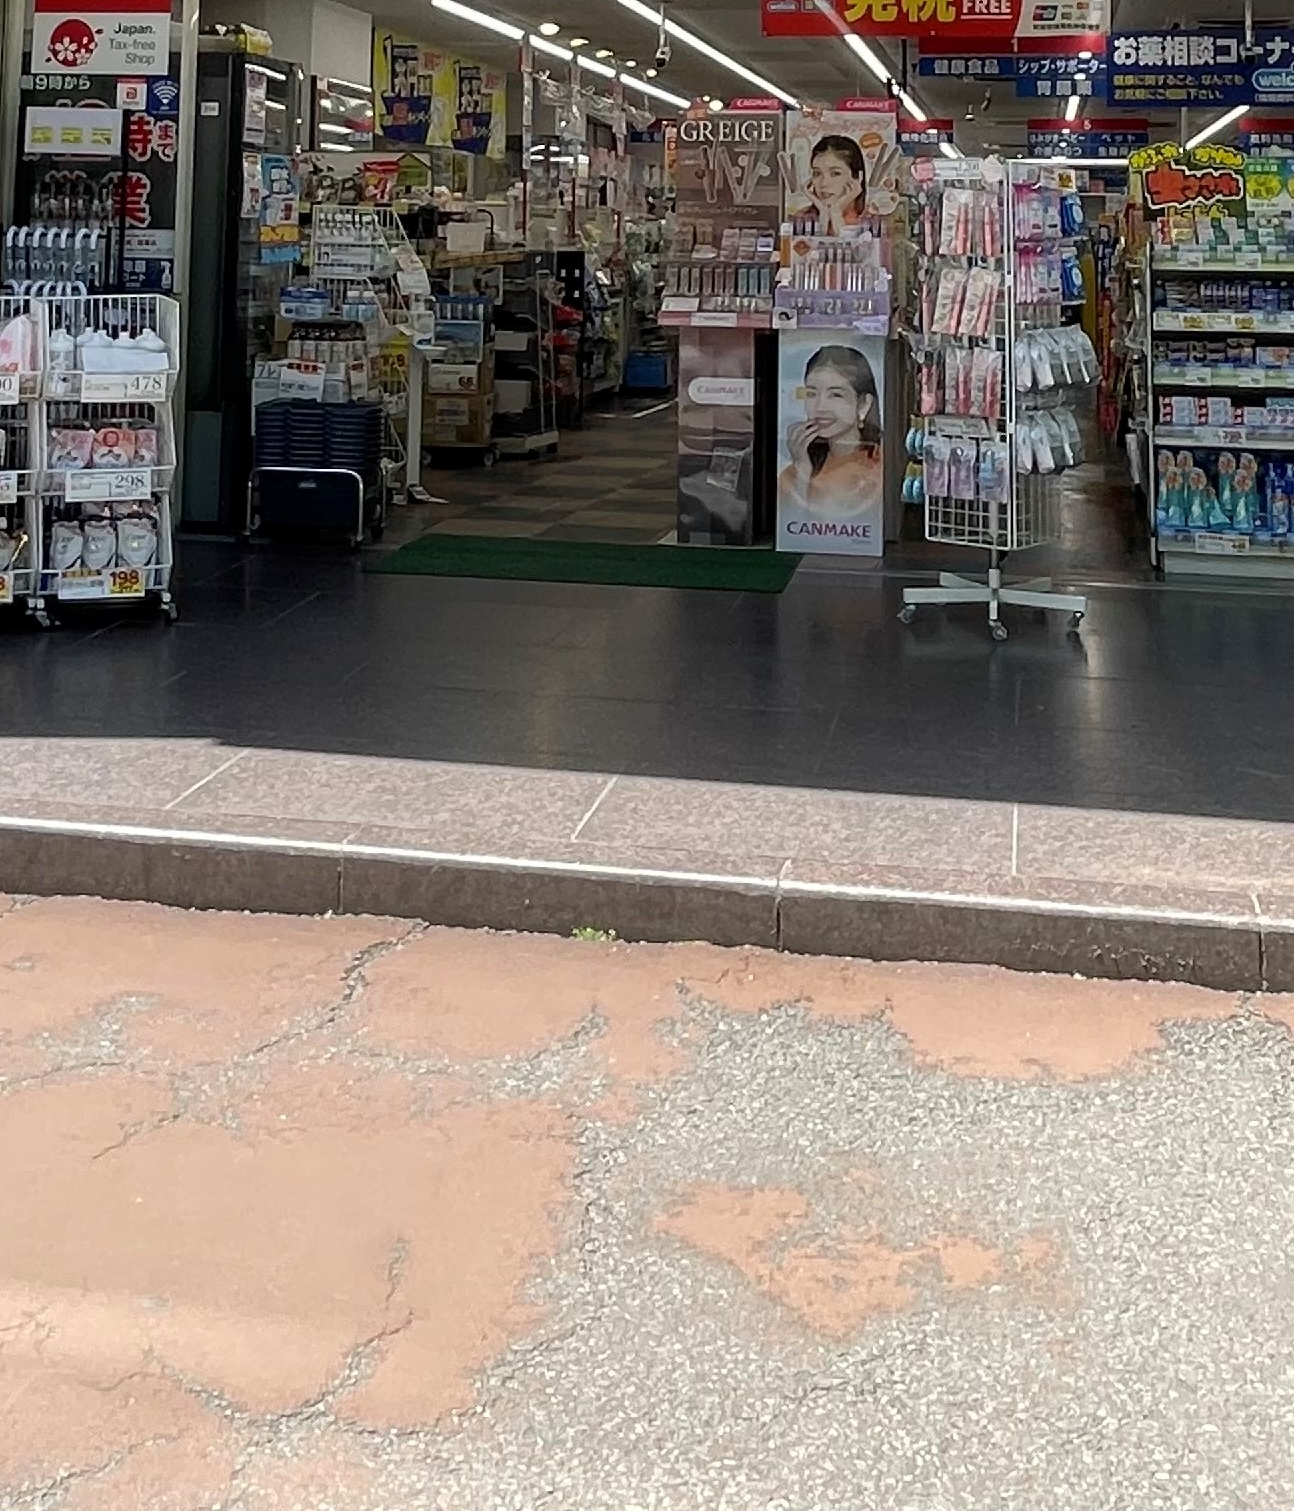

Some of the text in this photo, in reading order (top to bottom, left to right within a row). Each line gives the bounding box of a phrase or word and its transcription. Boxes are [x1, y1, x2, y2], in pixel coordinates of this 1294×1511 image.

[680, 119, 775, 142] GREIGE
[130, 376, 163, 390] 478
[114, 473, 145, 489] 298
[786, 520, 872, 539] CANMAKE
[109, 570, 140, 587] 198
